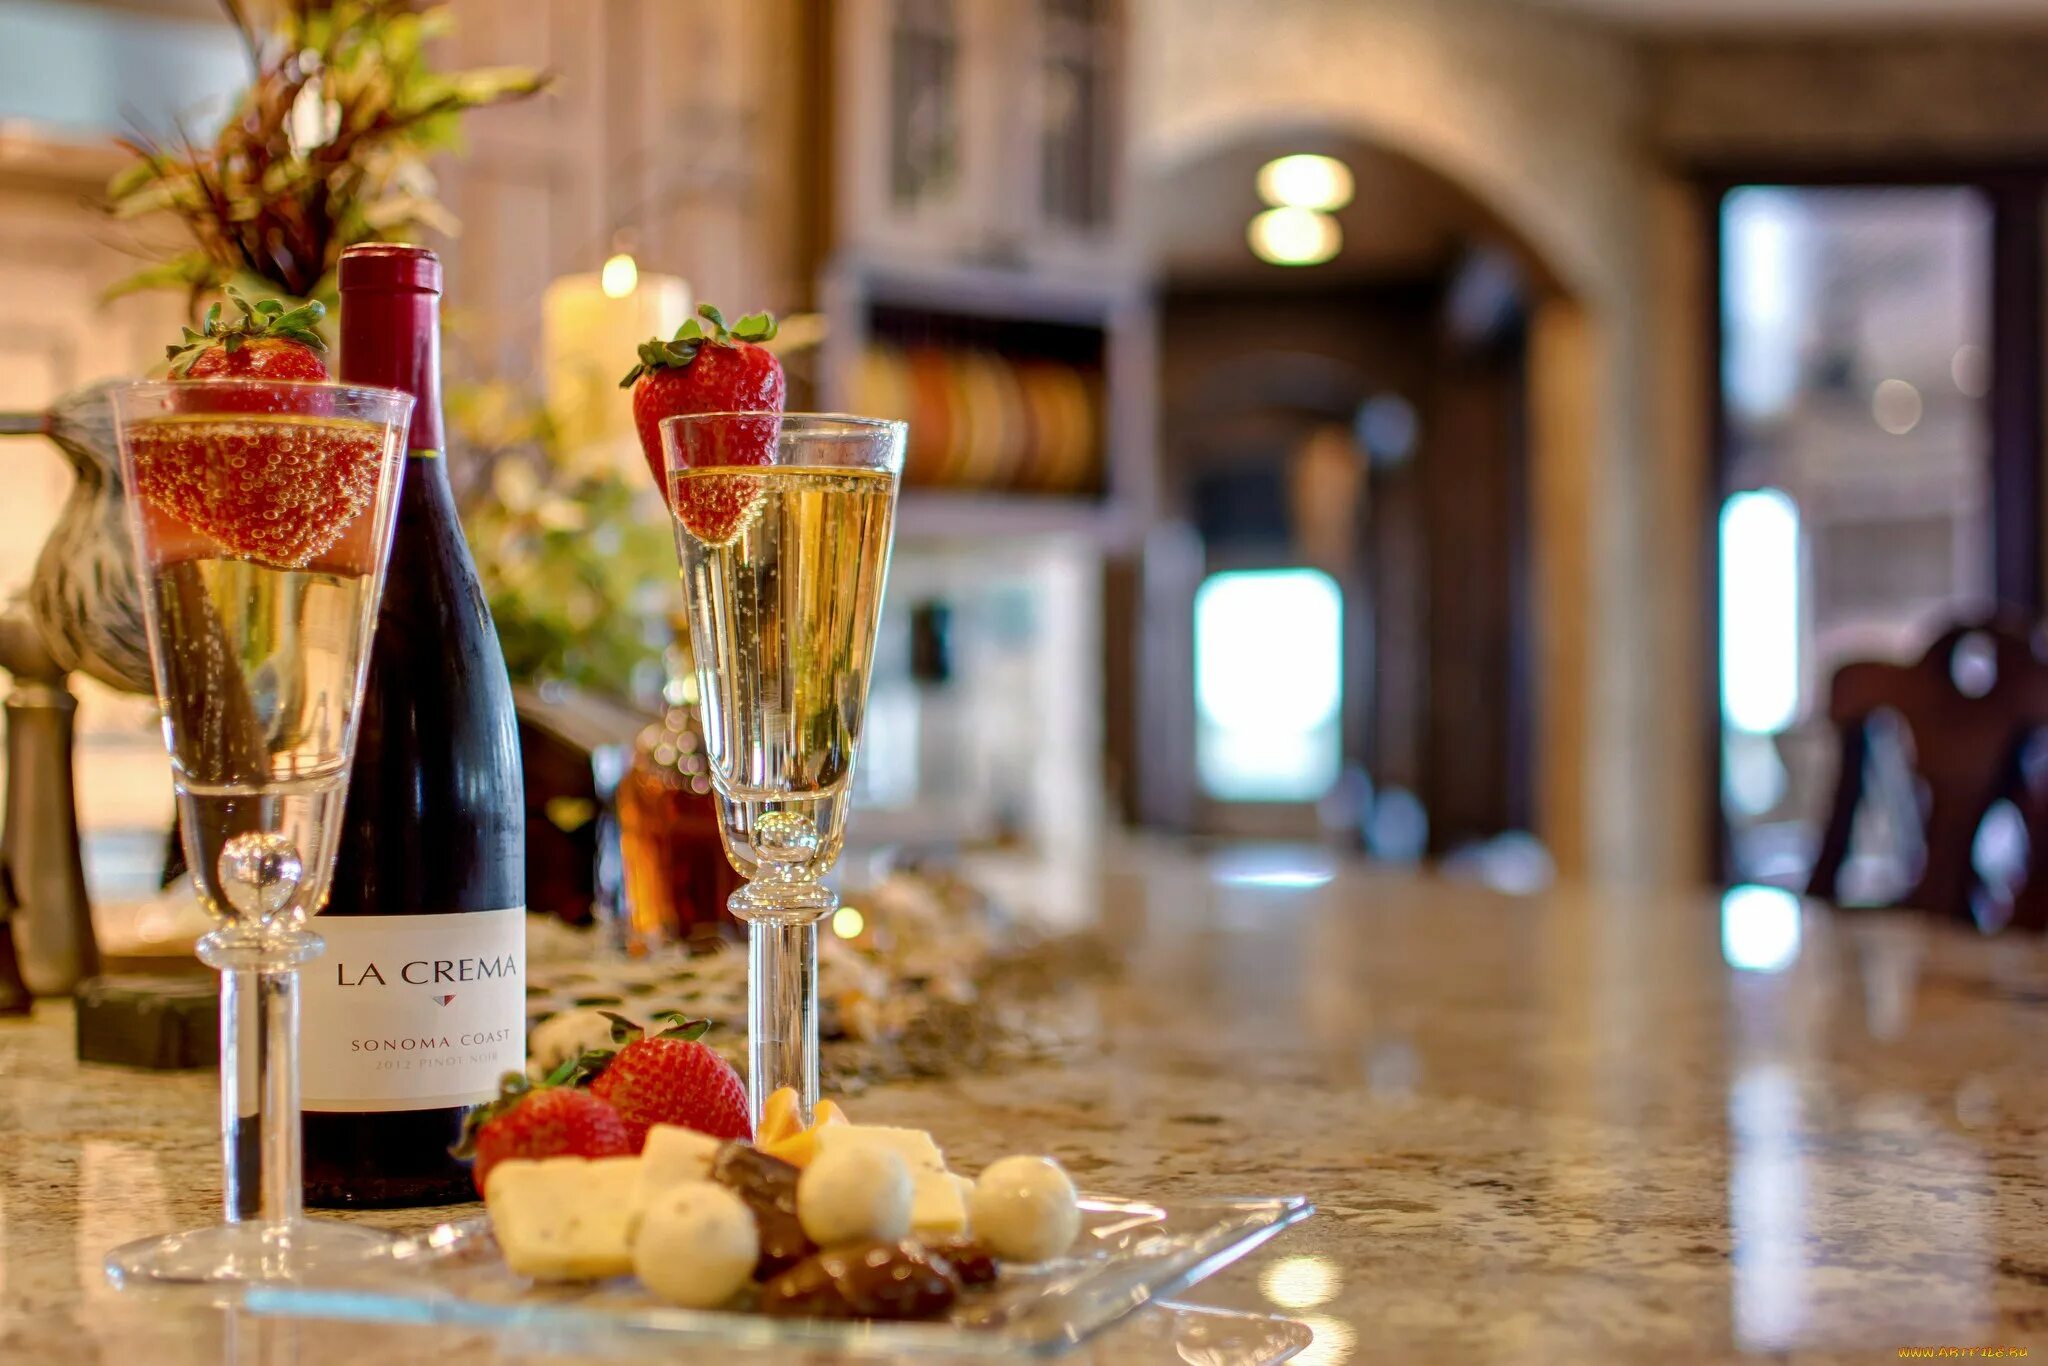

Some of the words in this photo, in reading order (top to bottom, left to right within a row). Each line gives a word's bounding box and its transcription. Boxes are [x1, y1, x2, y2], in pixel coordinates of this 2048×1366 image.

[337, 962, 387, 986] LA
[400, 953, 517, 985] CREMA
[351, 1036, 451, 1053] SONOMA
[460, 1028, 511, 1047] COAST
[375, 1059, 412, 1071] 2012
[419, 1055, 463, 1069] PINOT
[470, 1051, 499, 1065] NOIR
